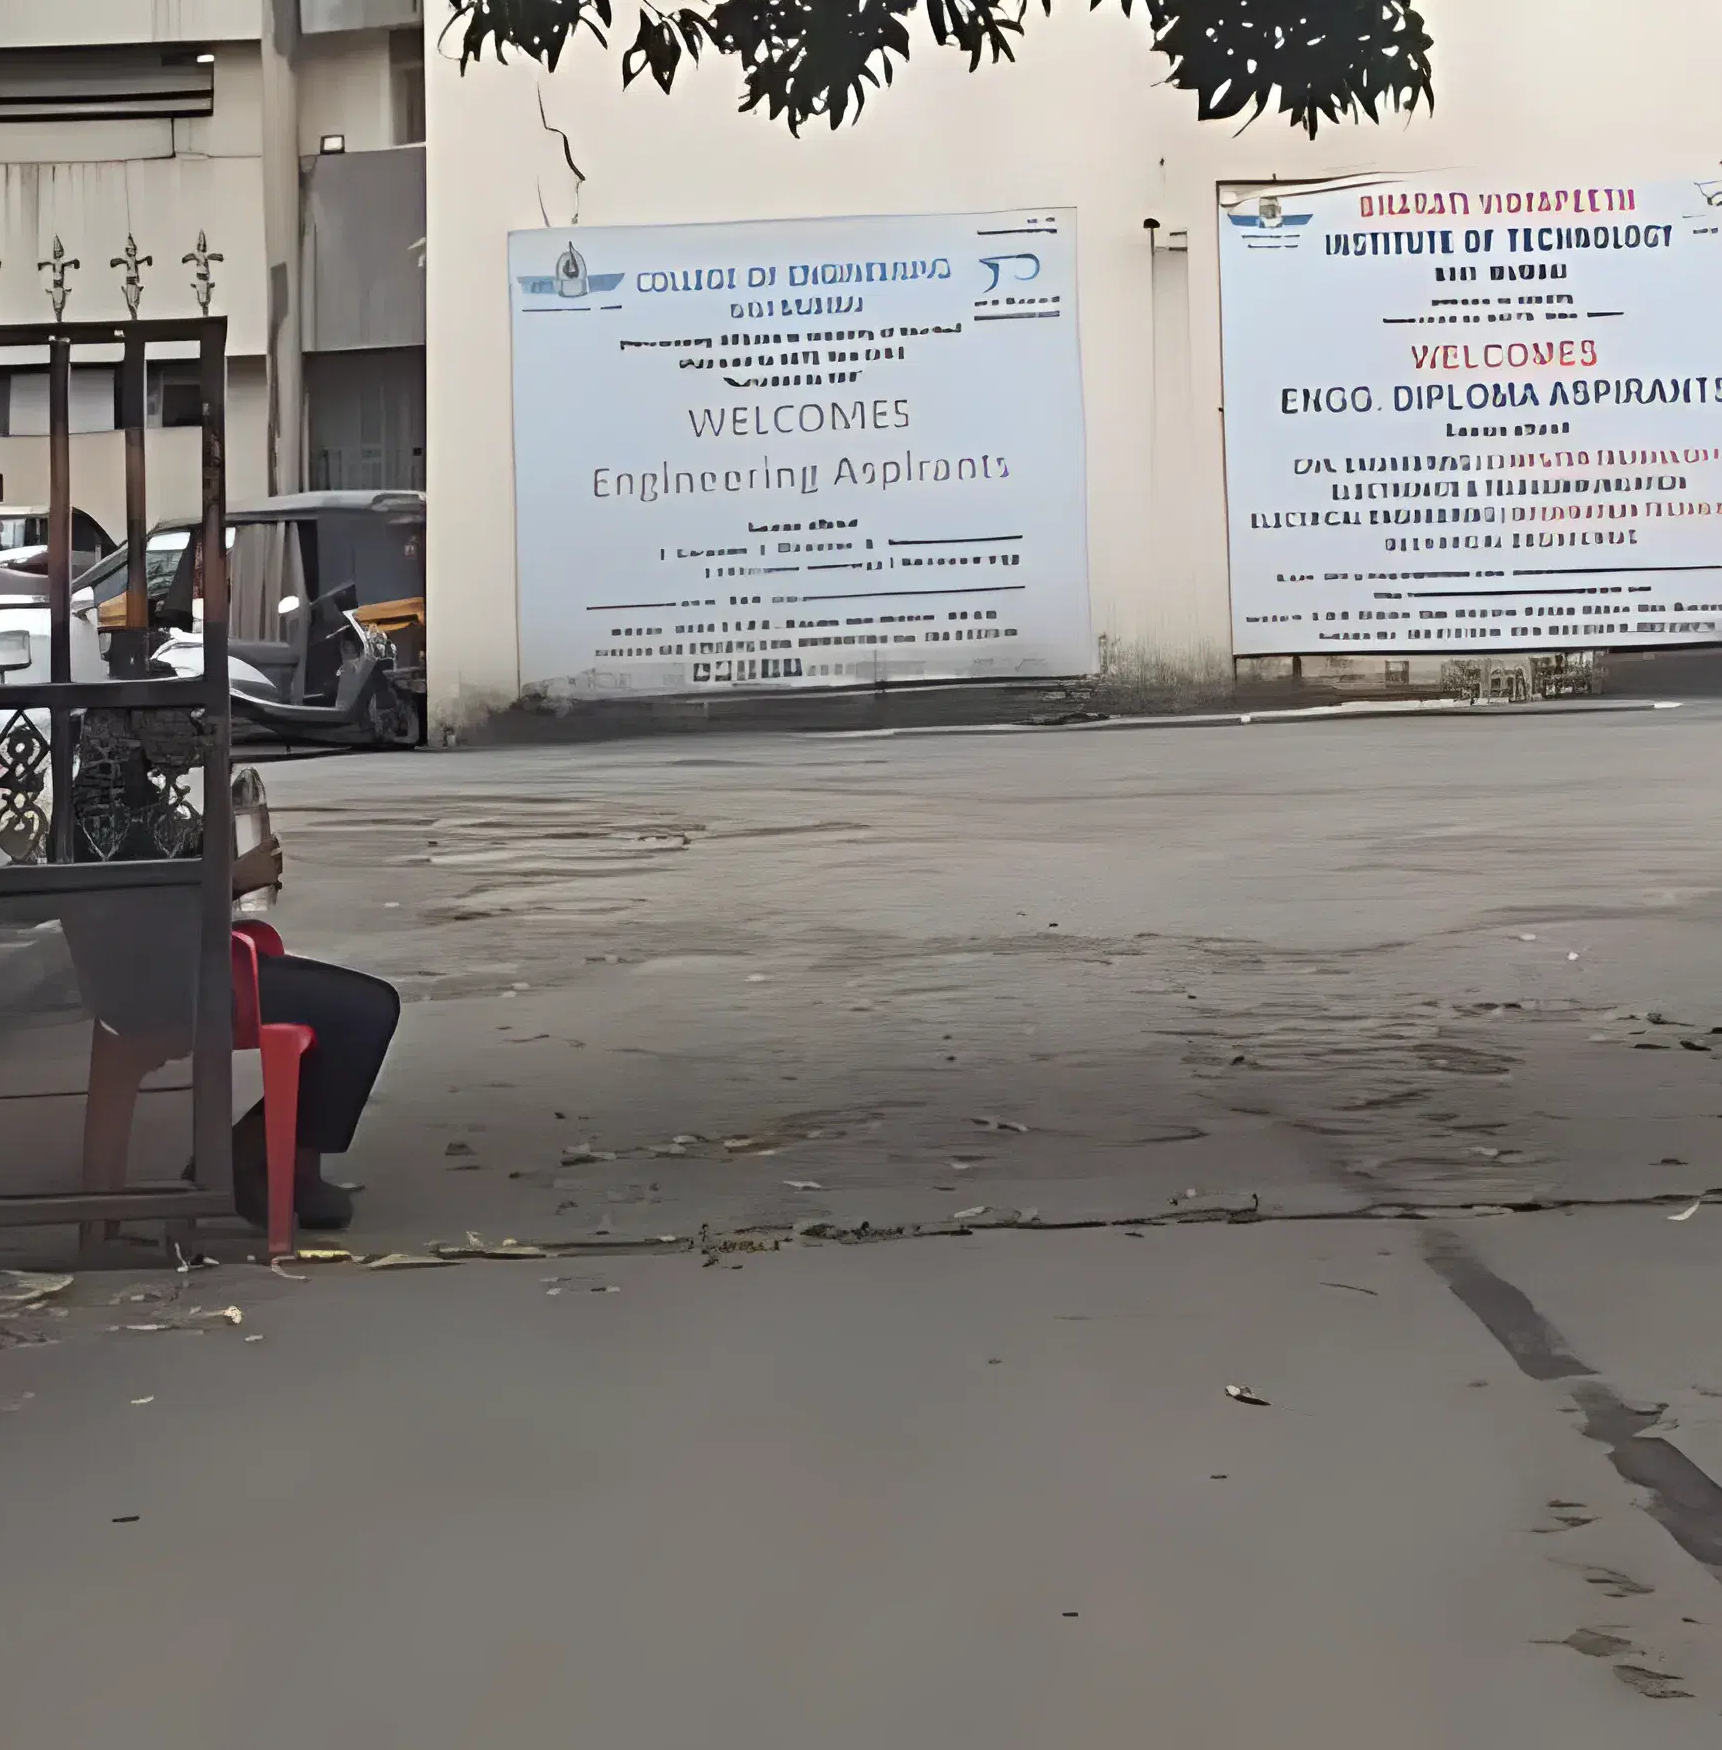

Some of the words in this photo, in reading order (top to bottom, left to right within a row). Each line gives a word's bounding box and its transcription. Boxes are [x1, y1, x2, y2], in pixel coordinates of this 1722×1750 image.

[1411, 339, 1598, 370] WELCOMES
[688, 399, 910, 438] WELCOMES
[593, 455, 819, 503] Engineering
